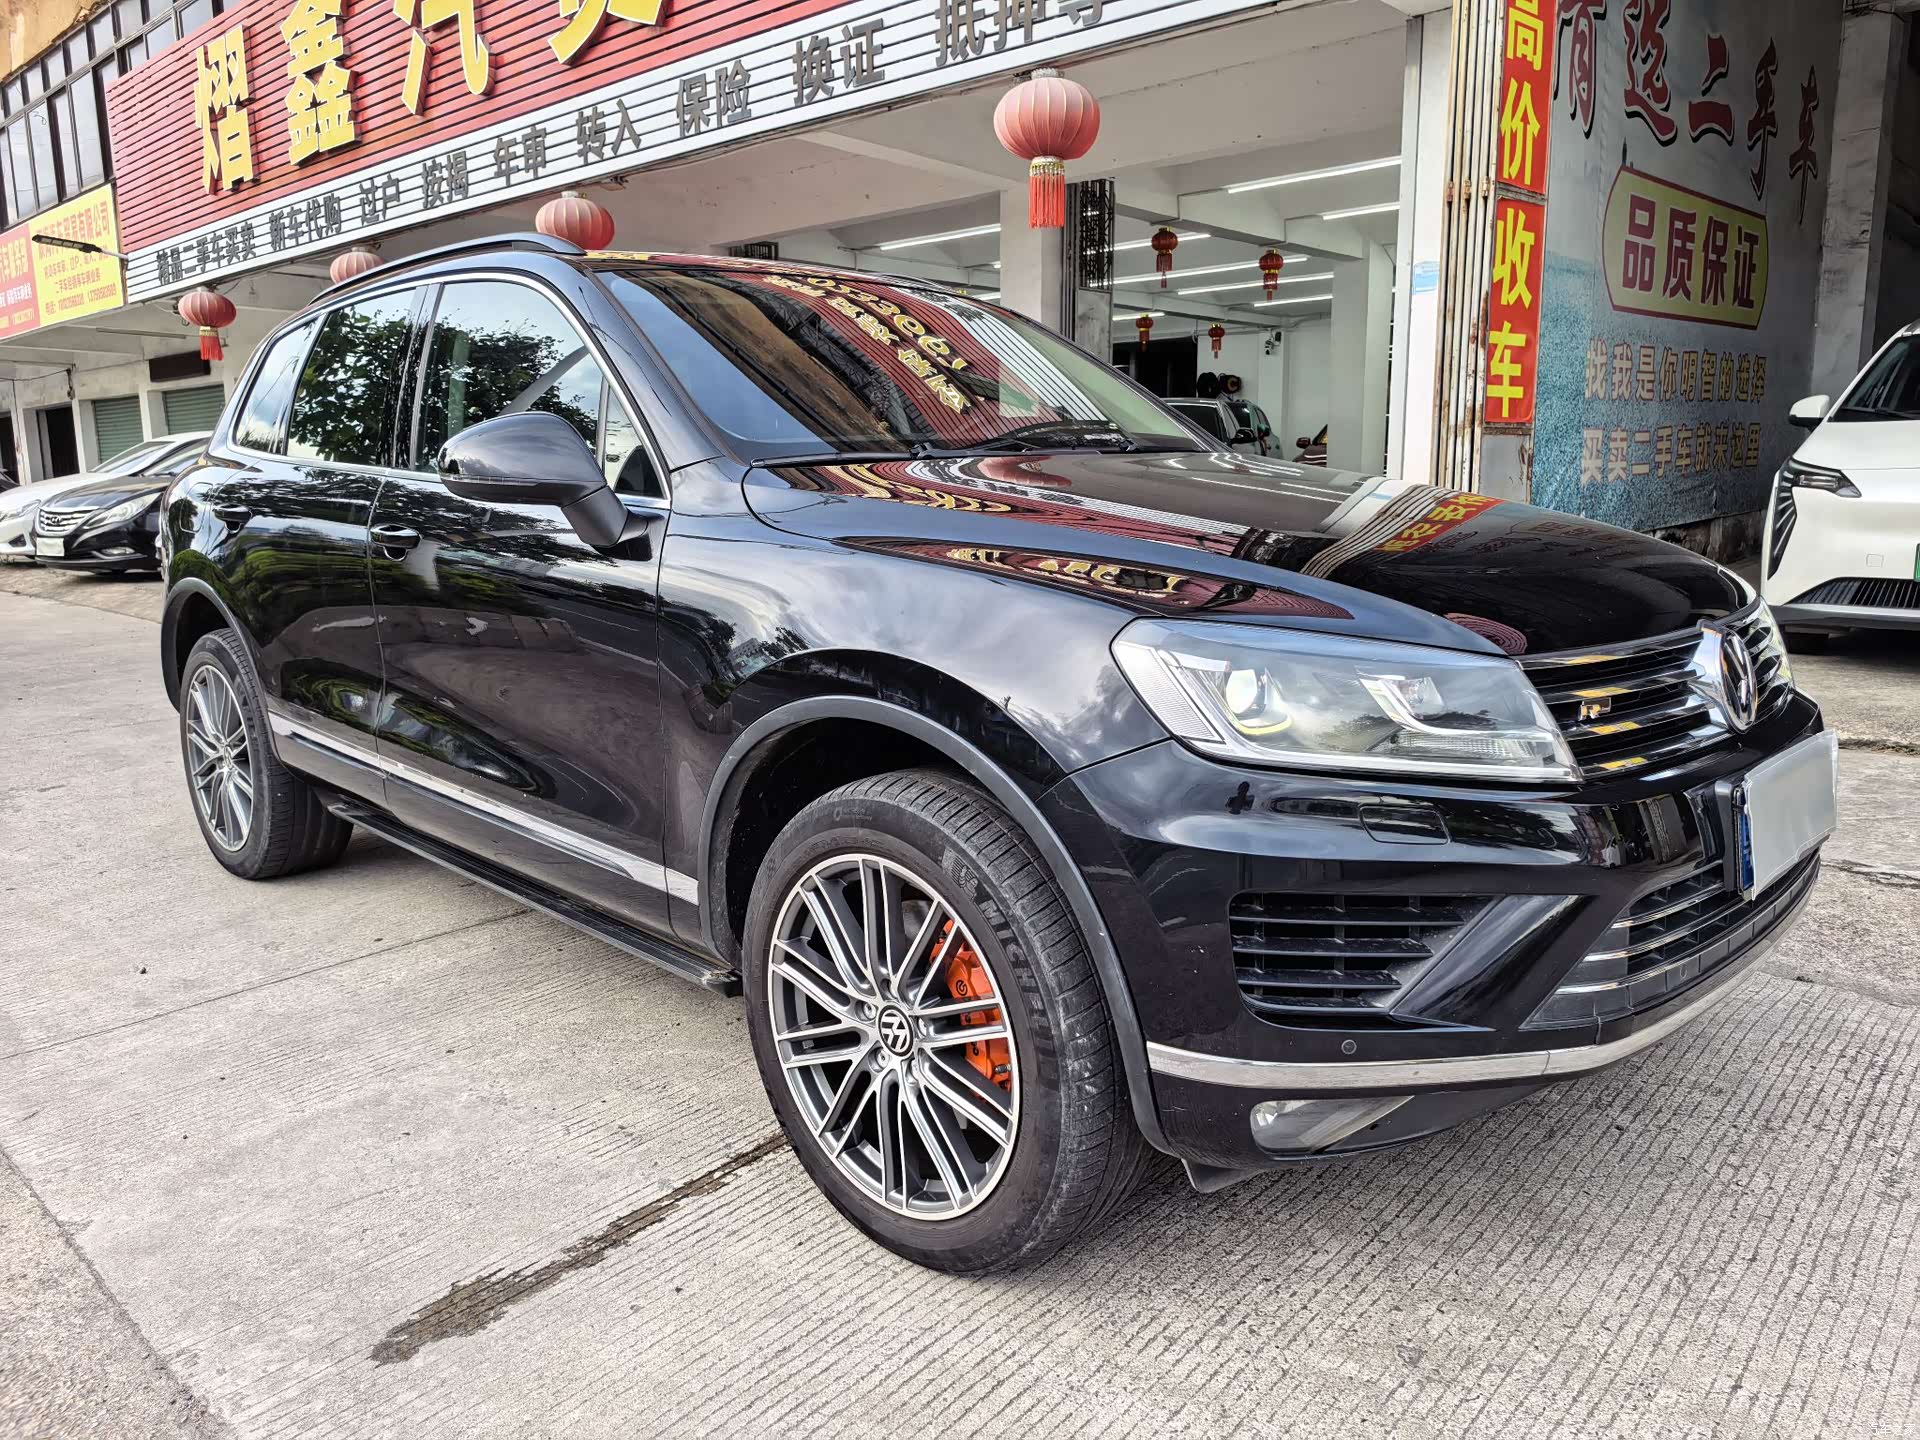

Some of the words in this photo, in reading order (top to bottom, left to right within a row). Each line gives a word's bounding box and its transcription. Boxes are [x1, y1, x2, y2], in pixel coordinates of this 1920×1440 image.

[157, 221, 257, 286] 精品二手车买卖
[269, 193, 342, 250] 新车代购
[359, 173, 401, 226] 过户
[422, 150, 469, 209] 按揭
[494, 125, 548, 187] 年审
[575, 98, 642, 165] 转入
[675, 59, 752, 137] 保险
[792, 18, 886, 106] 换证
[193, 0, 663, 194] 熠鑫汽
[1486, 0, 1543, 418] 高价收车
[1622, 193, 1760, 310] 品质保证
[1585, 336, 1767, 402] 找我是你明智的选择
[1582, 422, 1761, 487] 买卖二手车就来这里
